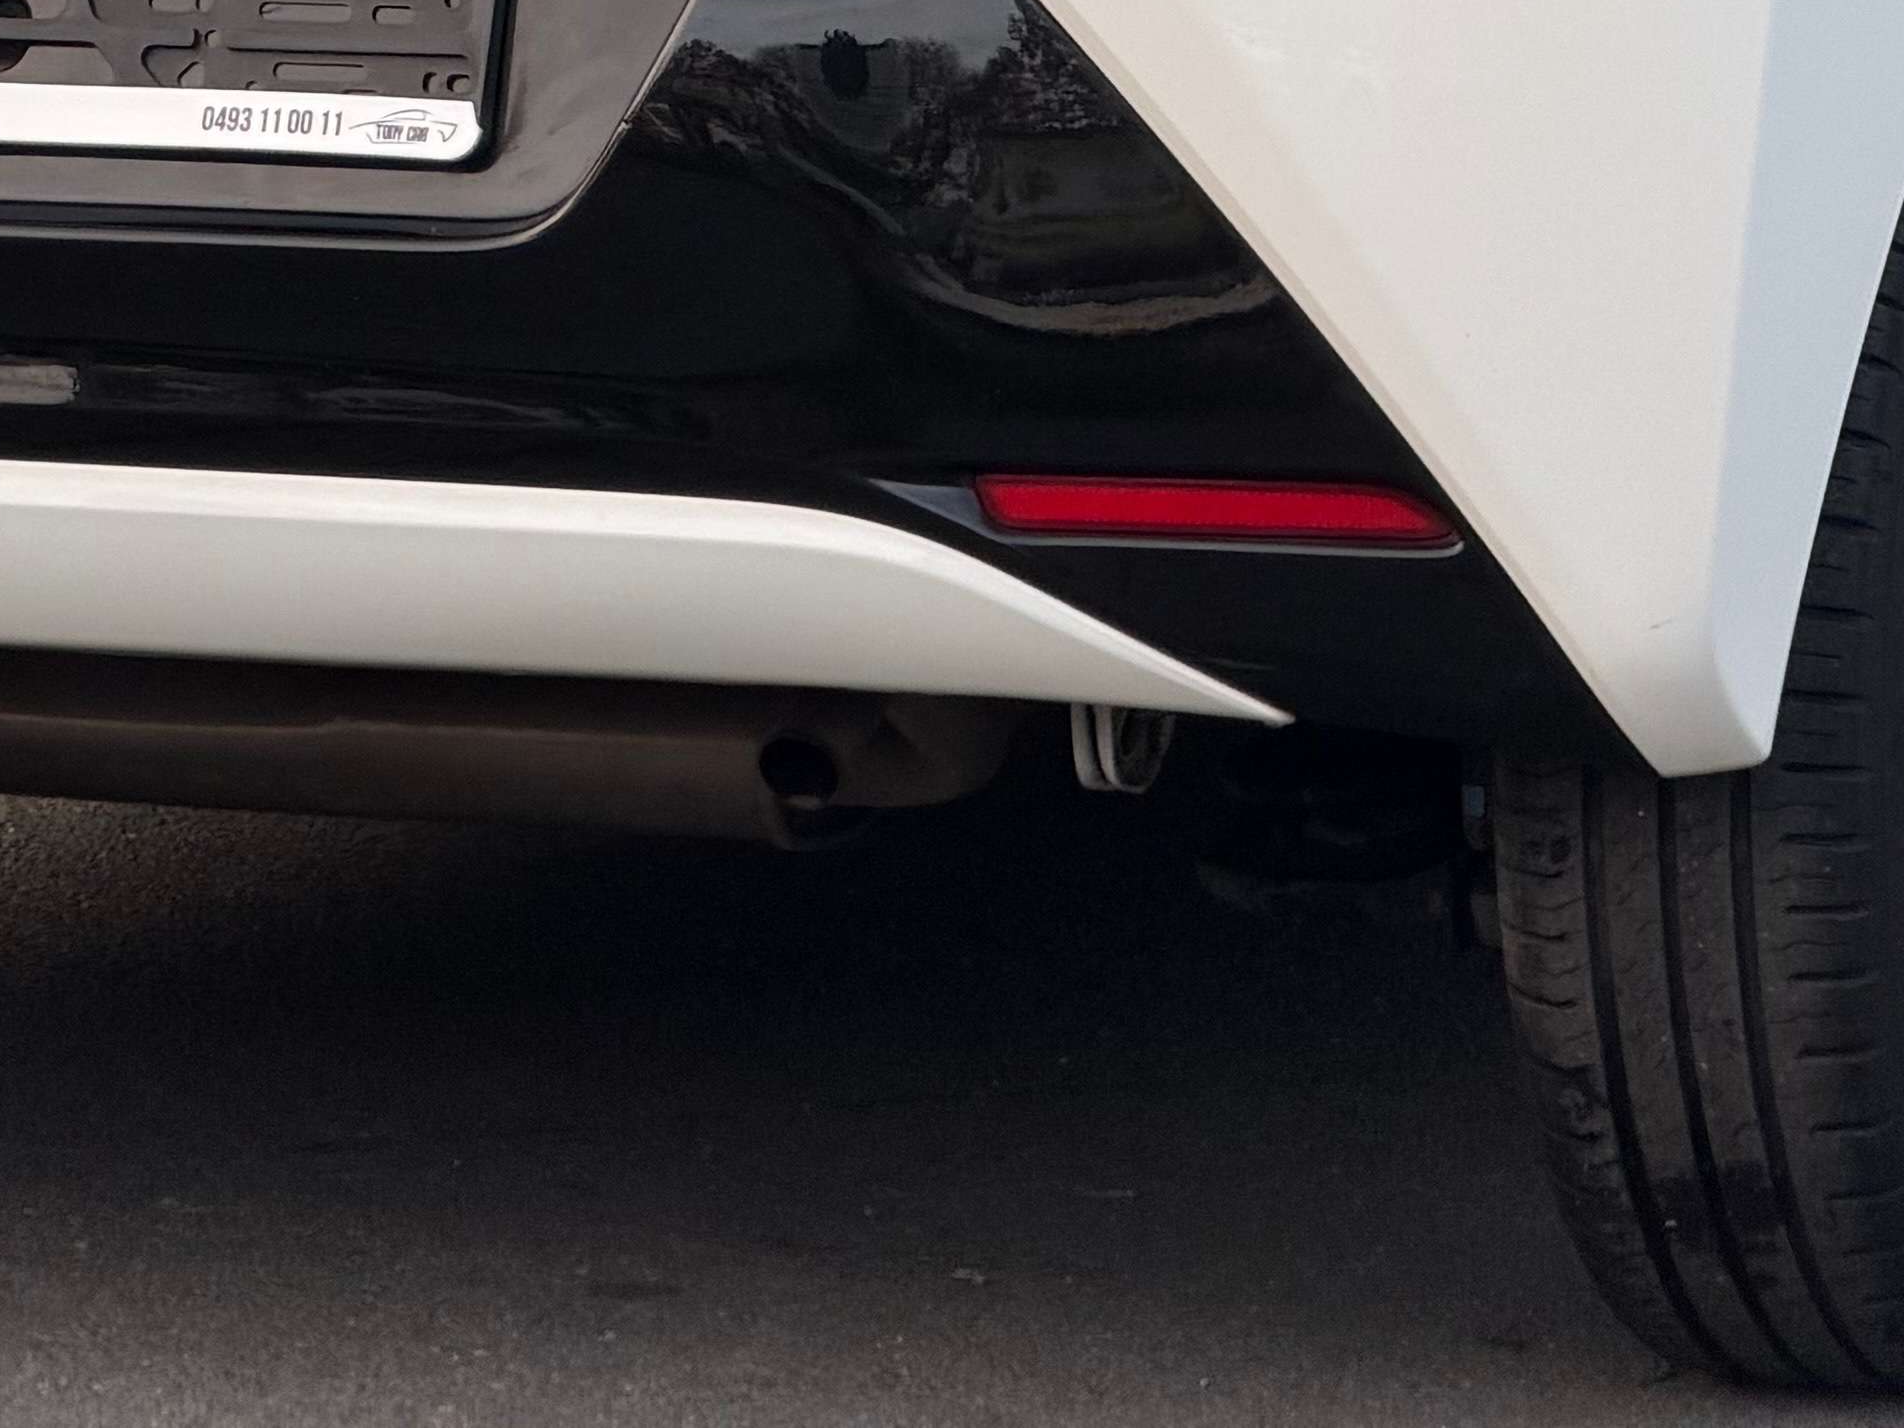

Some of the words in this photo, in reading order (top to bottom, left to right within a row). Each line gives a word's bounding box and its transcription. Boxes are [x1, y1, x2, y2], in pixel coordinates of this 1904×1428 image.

[201, 106, 252, 132] 0493
[260, 107, 282, 134] 11
[287, 109, 313, 135] 00
[321, 111, 343, 137] 11
